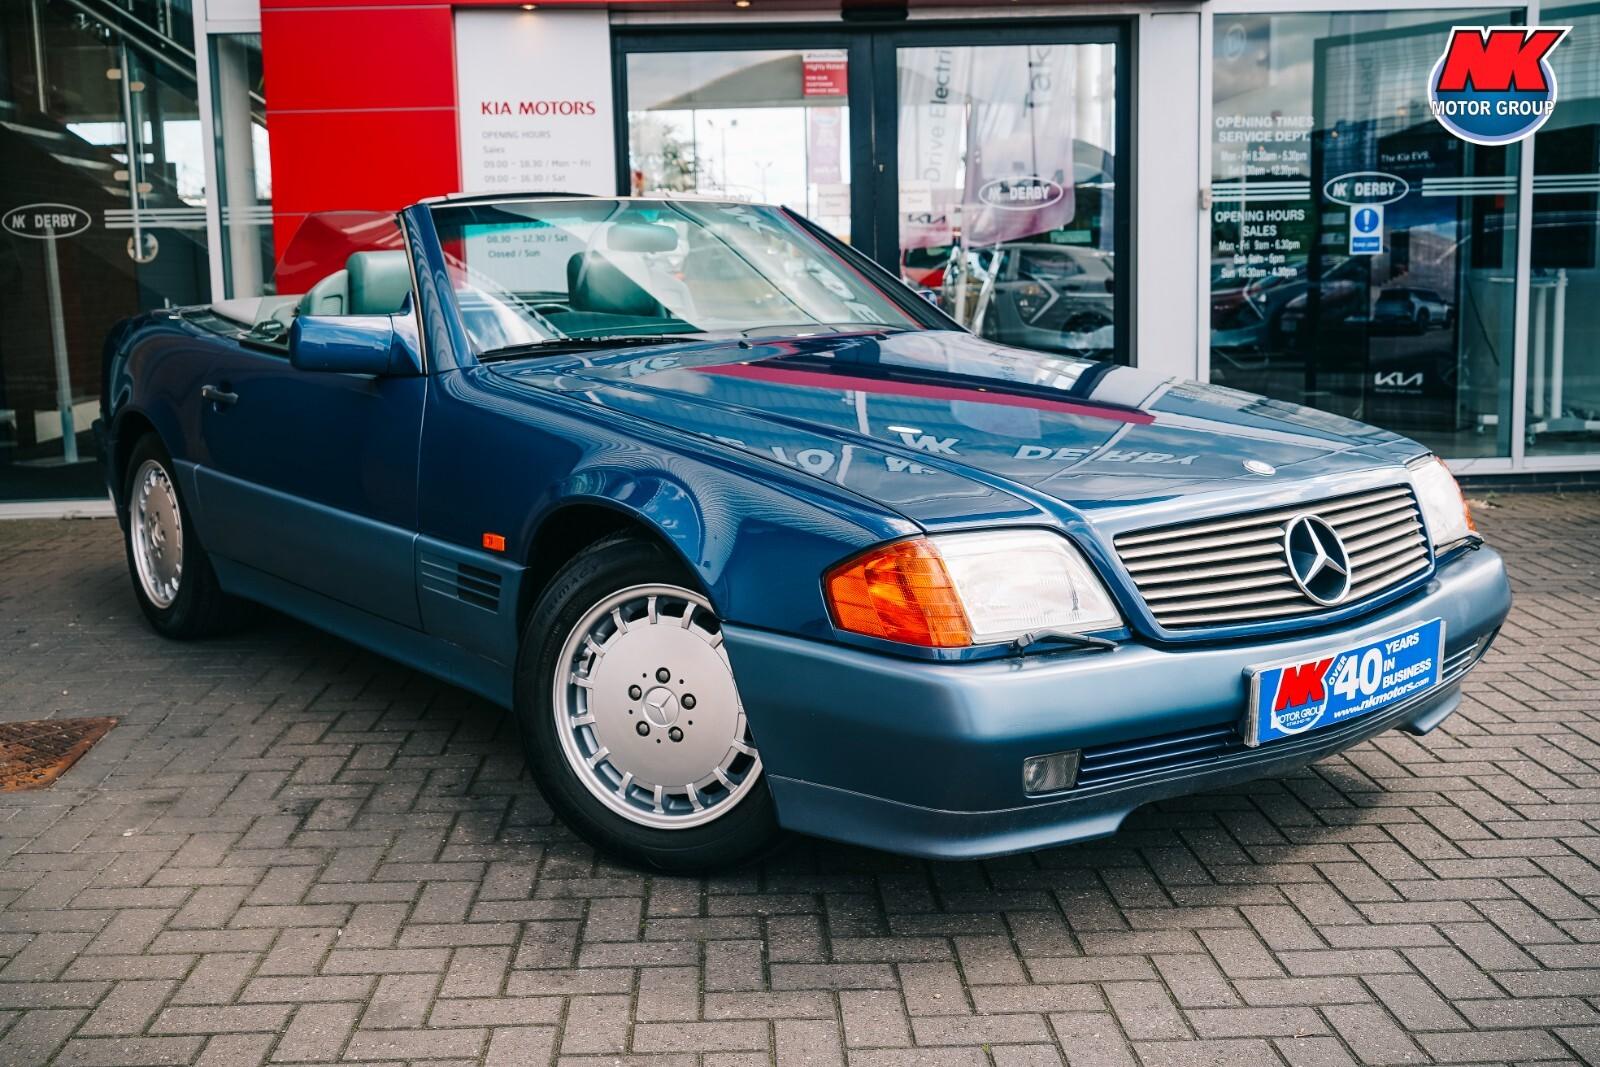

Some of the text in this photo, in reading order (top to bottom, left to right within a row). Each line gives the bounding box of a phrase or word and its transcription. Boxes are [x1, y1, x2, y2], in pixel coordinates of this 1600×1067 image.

[481, 101, 597, 115] KIA MOTORS
[1215, 116, 1315, 128] OPENING TIMES
[481, 130, 551, 139] OPENING HOURS
[1218, 131, 1311, 142] SERVICE DEPT.
[923, 126, 945, 183] Drive
[1009, 185, 1050, 200] DERBY
[1354, 182, 1396, 196] DERBY
[34, 213, 77, 228] DERBY
[1214, 209, 1305, 223] OPENING HOURS
[1242, 225, 1277, 237] SALES
[1385, 632, 1420, 655] YEARS
[1328, 655, 1348, 686] OVER
[1383, 656, 1396, 673] IN
[1334, 647, 1383, 701] 40
[1382, 657, 1432, 689] BUSINESS
[1274, 656, 1335, 711] NK
[1333, 677, 1430, 719] www.nkmotors.com
